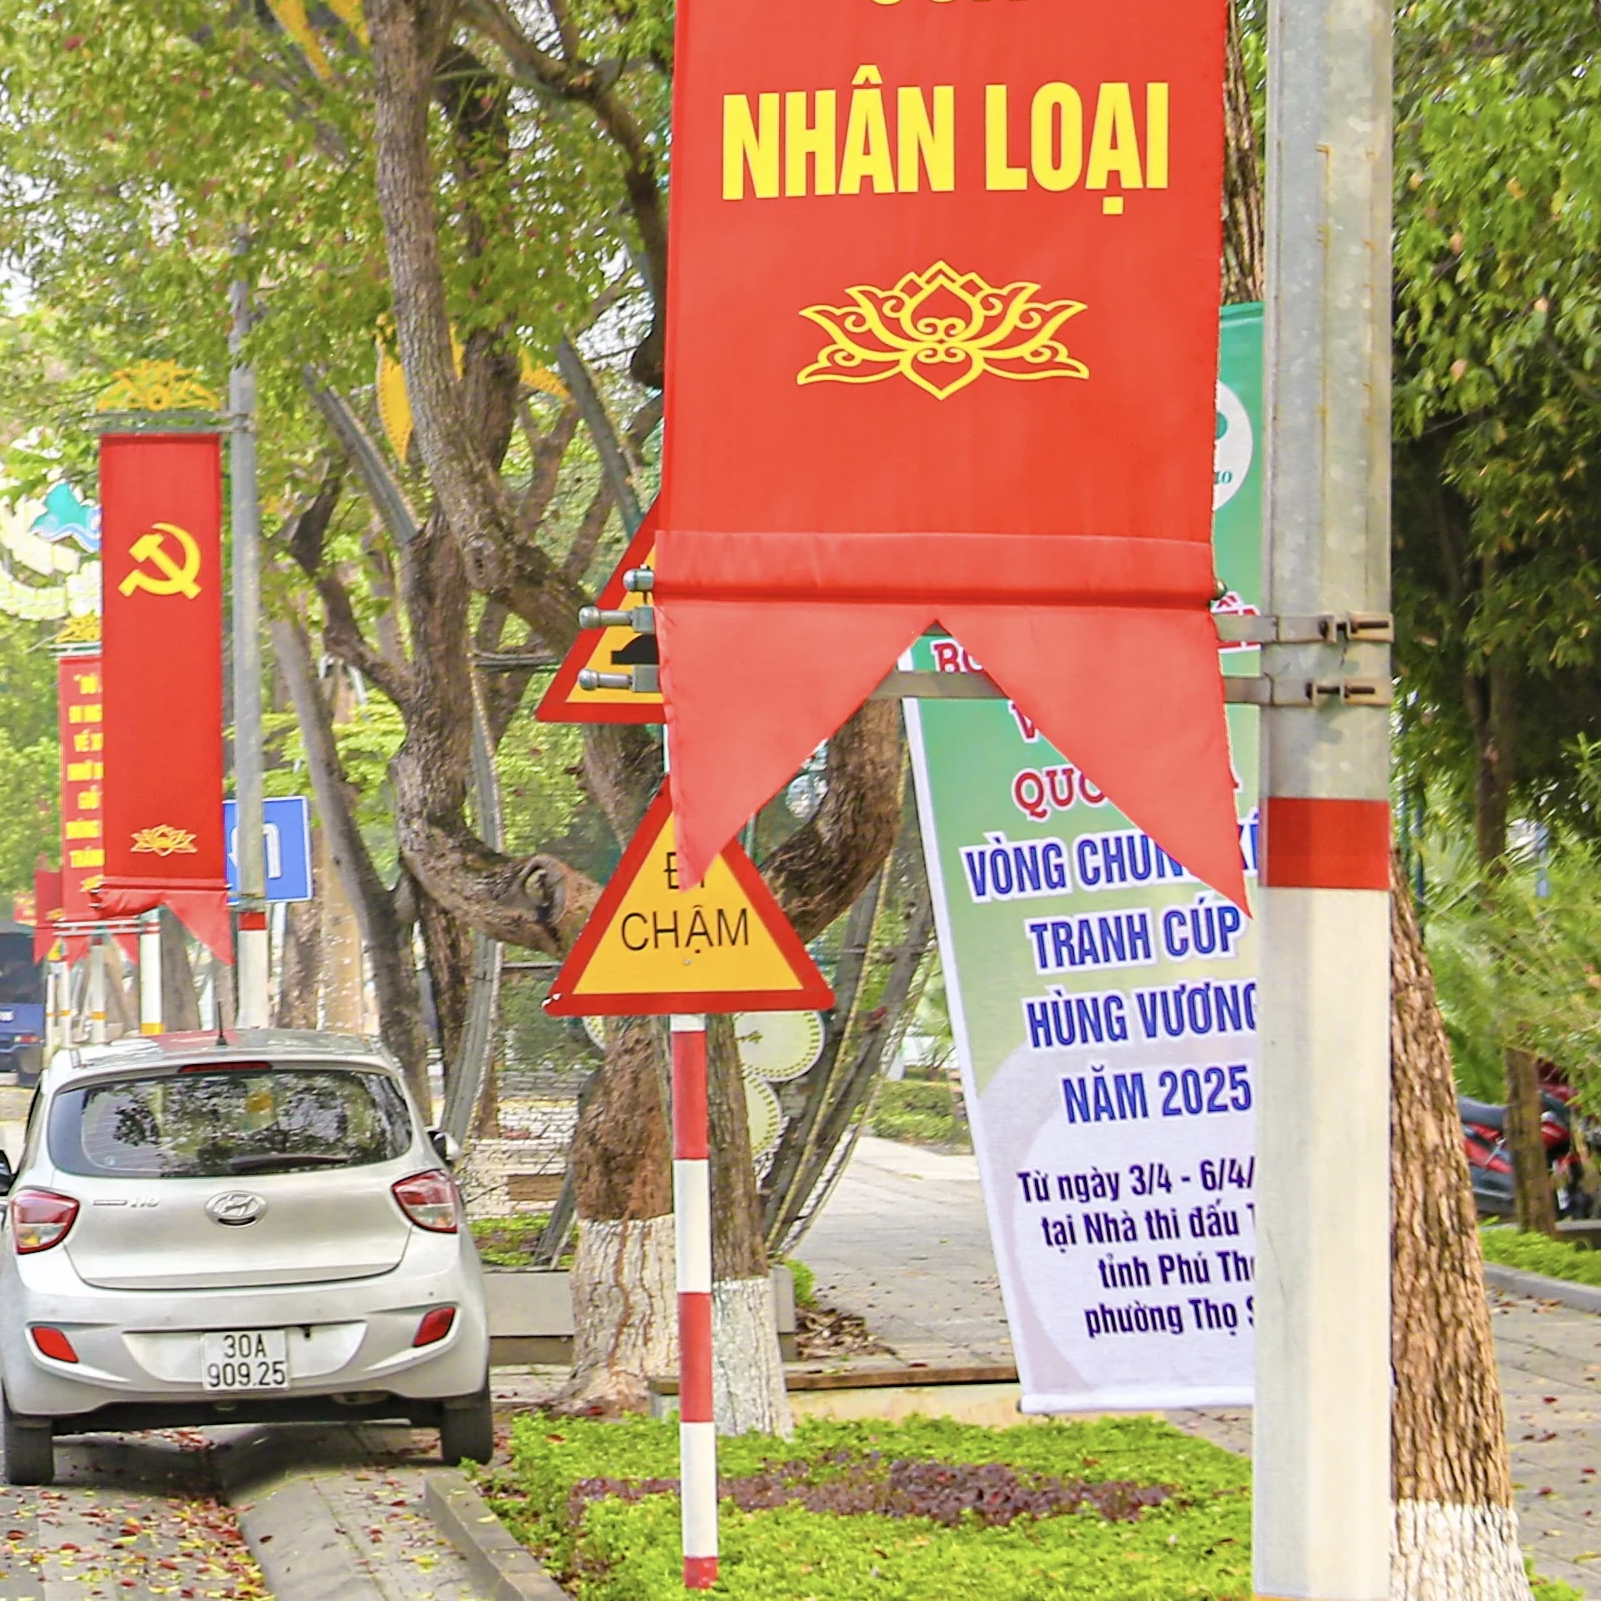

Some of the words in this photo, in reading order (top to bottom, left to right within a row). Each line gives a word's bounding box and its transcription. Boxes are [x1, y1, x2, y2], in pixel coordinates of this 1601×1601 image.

[722, 64, 955, 201] NHÂN
[985, 81, 1169, 215] LOẠI
[965, 836, 1067, 898] VÒNG
[620, 904, 750, 955] CHẬM
[1029, 913, 1152, 970] TRANH
[1163, 897, 1241, 958] CÚP
[1025, 989, 1129, 1049] HÙNG
[1061, 1064, 1149, 1125] NĂM
[1158, 1064, 1252, 1118] 2025
[1016, 1170, 1051, 1203] Từ
[1057, 1166, 1120, 1204] ngày
[1128, 1162, 1173, 1196] 3/4
[1200, 1156, 1256, 1191] 6/4/
[1040, 1213, 1077, 1254] tại
[1082, 1209, 1138, 1245] Nhà
[1144, 1207, 1181, 1241] thi
[1188, 1198, 1240, 1239] đấu
[1097, 1253, 1151, 1289] tỉnh
[1158, 1251, 1211, 1286] Phú
[1084, 1300, 1184, 1339] phường
[1188, 1297, 1238, 1336] Thọ
[222, 1333, 268, 1360] 30A
[207, 1360, 287, 1389] 909.25
